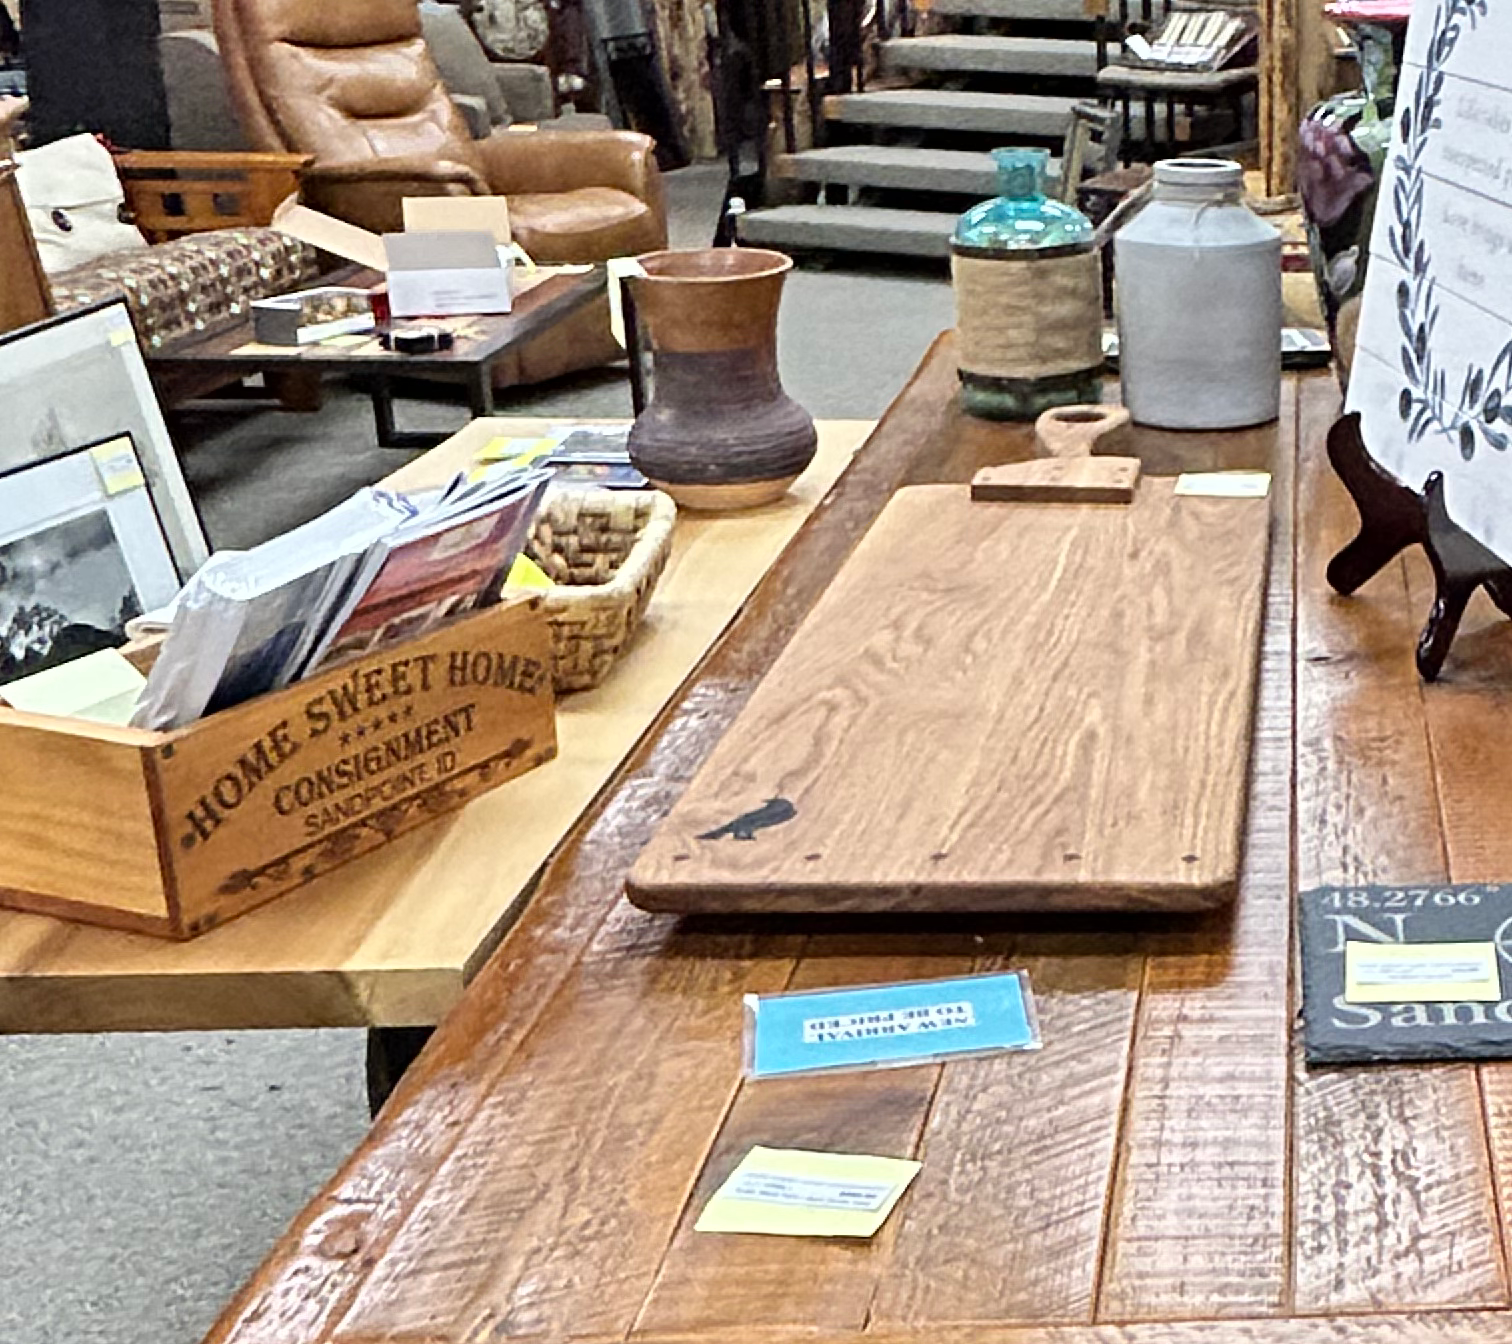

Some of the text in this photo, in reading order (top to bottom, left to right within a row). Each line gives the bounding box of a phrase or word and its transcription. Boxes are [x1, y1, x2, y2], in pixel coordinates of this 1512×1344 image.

[186, 651, 542, 842] HOME SWEET HOME
[274, 704, 476, 816] CONSIGNMENT
[436, 751, 457, 776] ID
[1324, 912, 1415, 953] N
